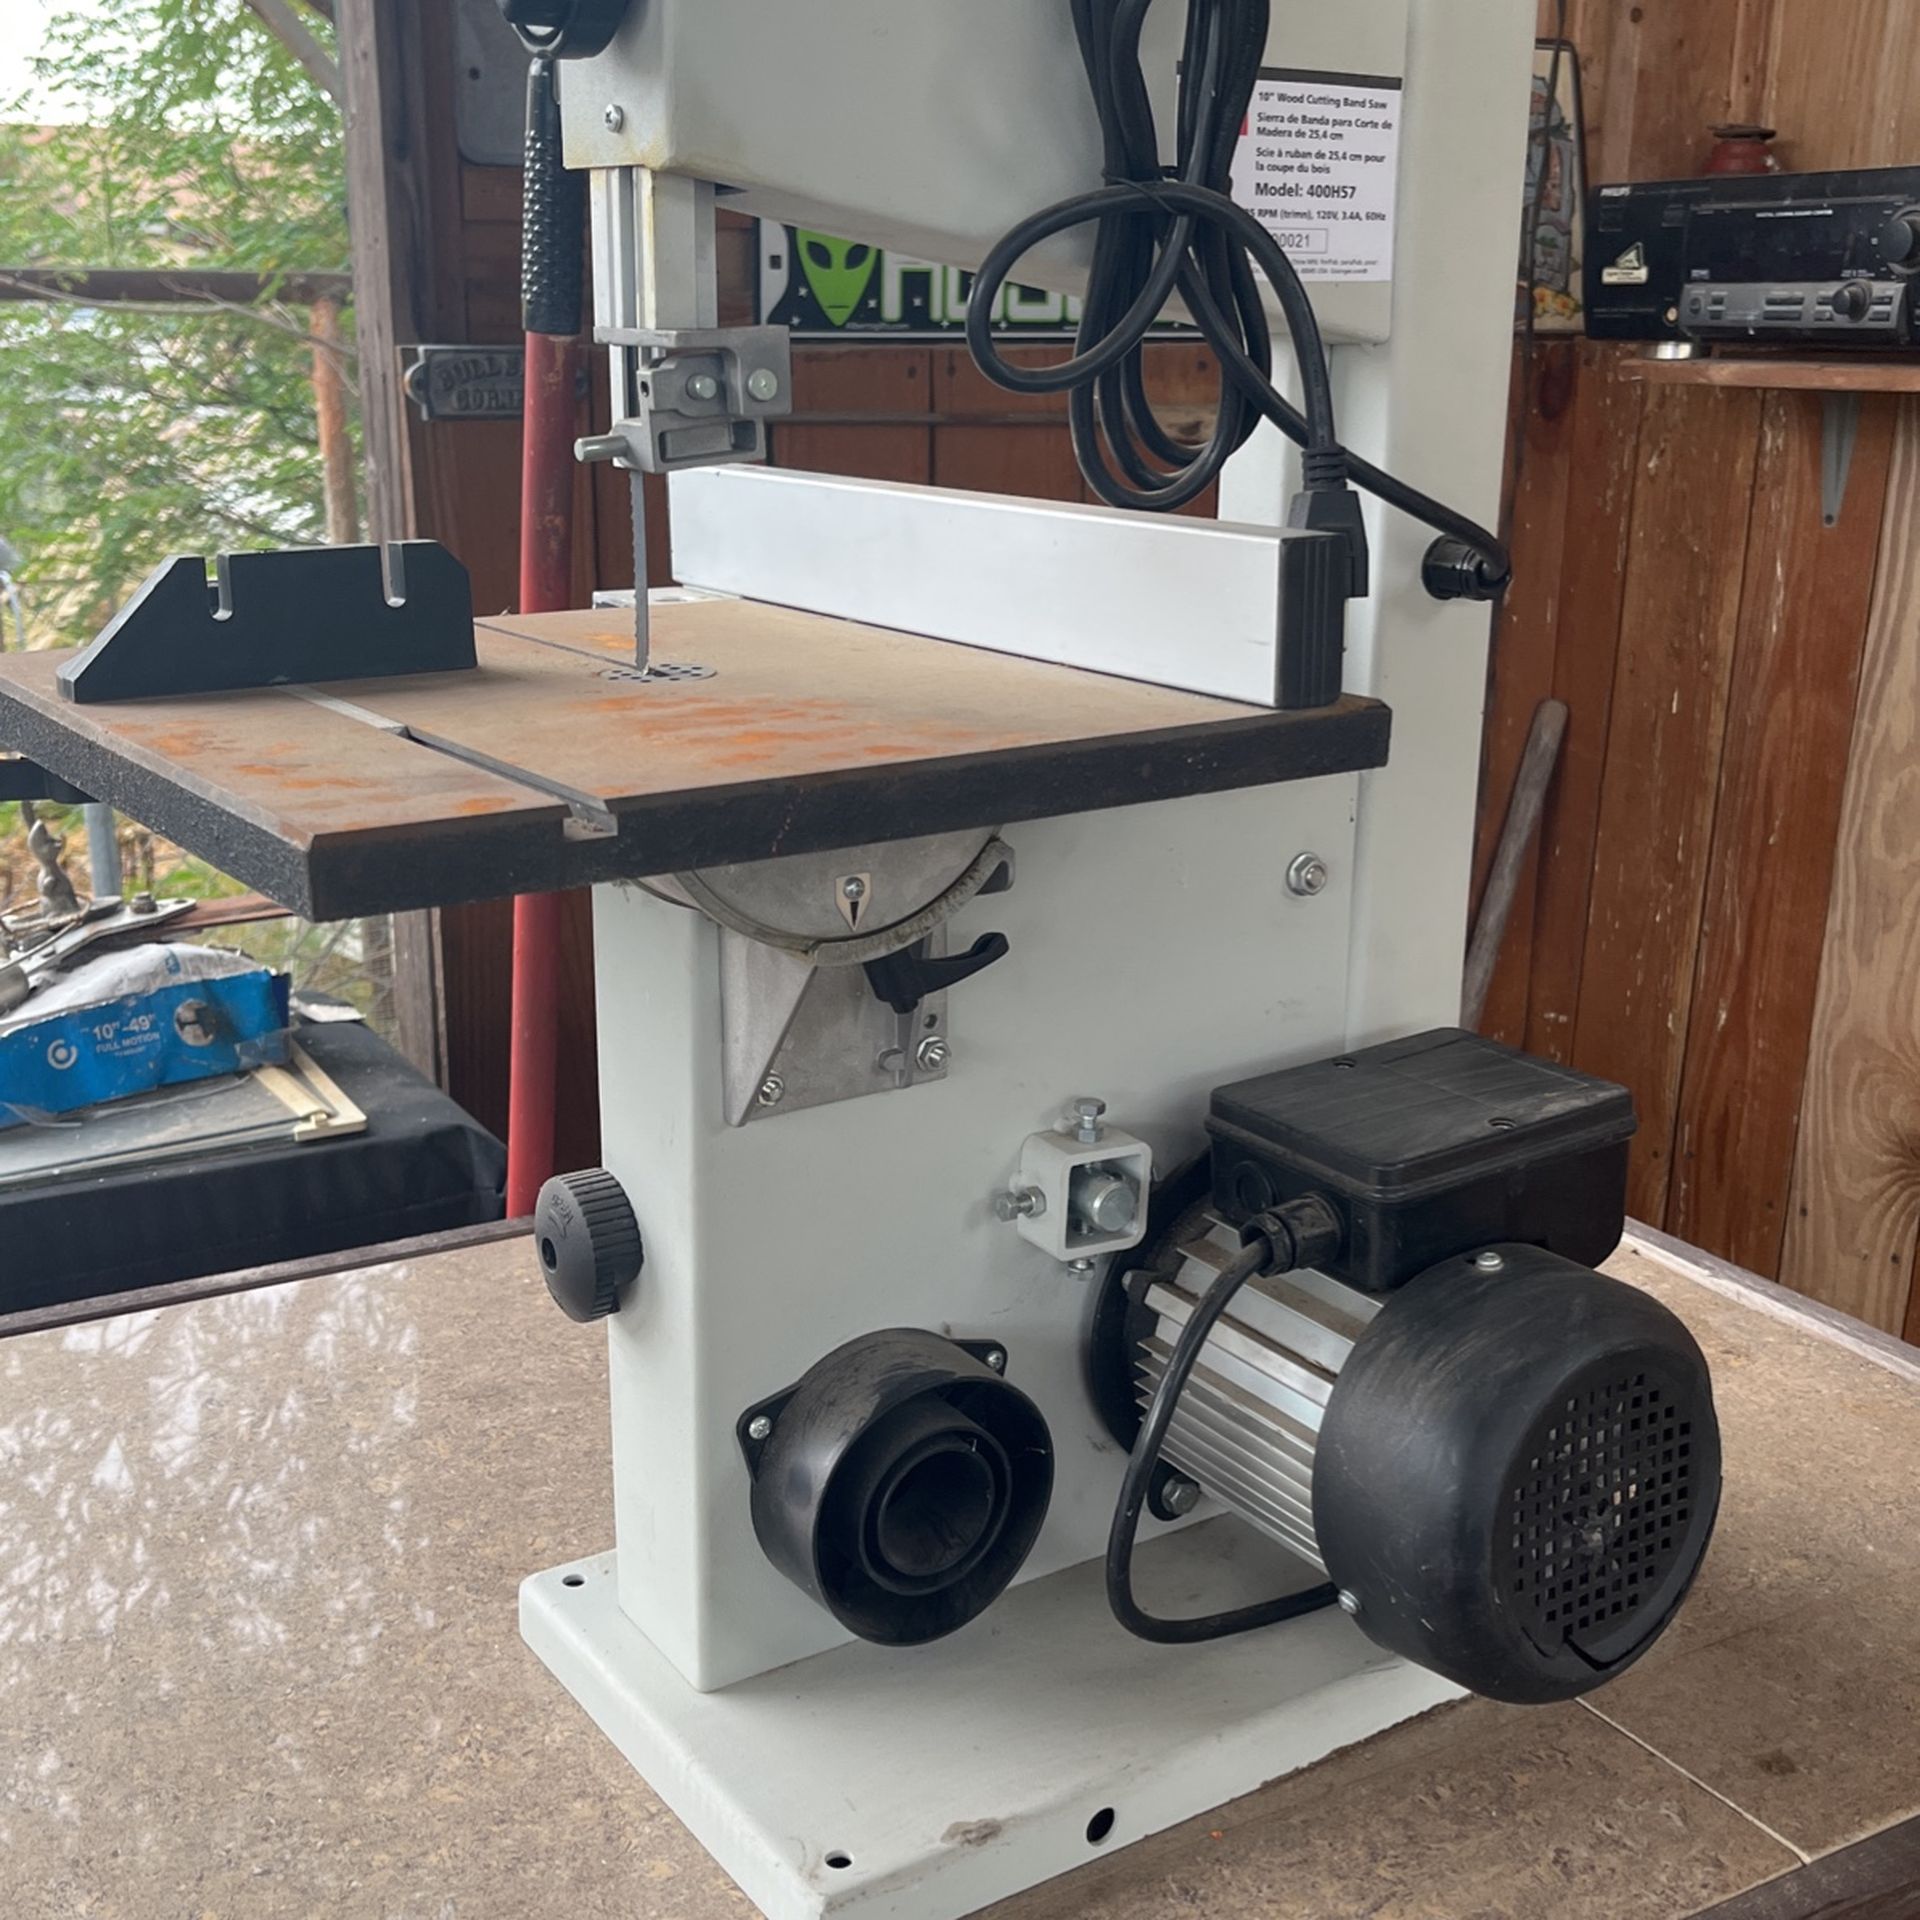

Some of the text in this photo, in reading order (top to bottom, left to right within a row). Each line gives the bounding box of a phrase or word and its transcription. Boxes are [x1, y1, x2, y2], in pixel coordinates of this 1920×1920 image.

[1277, 93, 1304, 104] Wood
[1306, 94, 1341, 108] Cutting
[1343, 97, 1366, 108] Band
[1368, 99, 1388, 109] Saw
[1257, 112, 1393, 130] Sierra de Banda para Corte de
[1257, 127, 1292, 138] Madera
[1294, 129, 1306, 138] de
[1329, 132, 1344, 140] cm
[1256, 147, 1275, 157] Scie
[1285, 149, 1313, 159] ruban
[1314, 150, 1327, 160] de
[1348, 153, 1362, 161] cm
[1364, 154, 1386, 164] pour
[1255, 161, 1331, 174] la coupe du bois
[1255, 182, 1303, 197] Model:
[1257, 208, 1278, 218] RPM
[122, 1032, 160, 1047] MOTION
